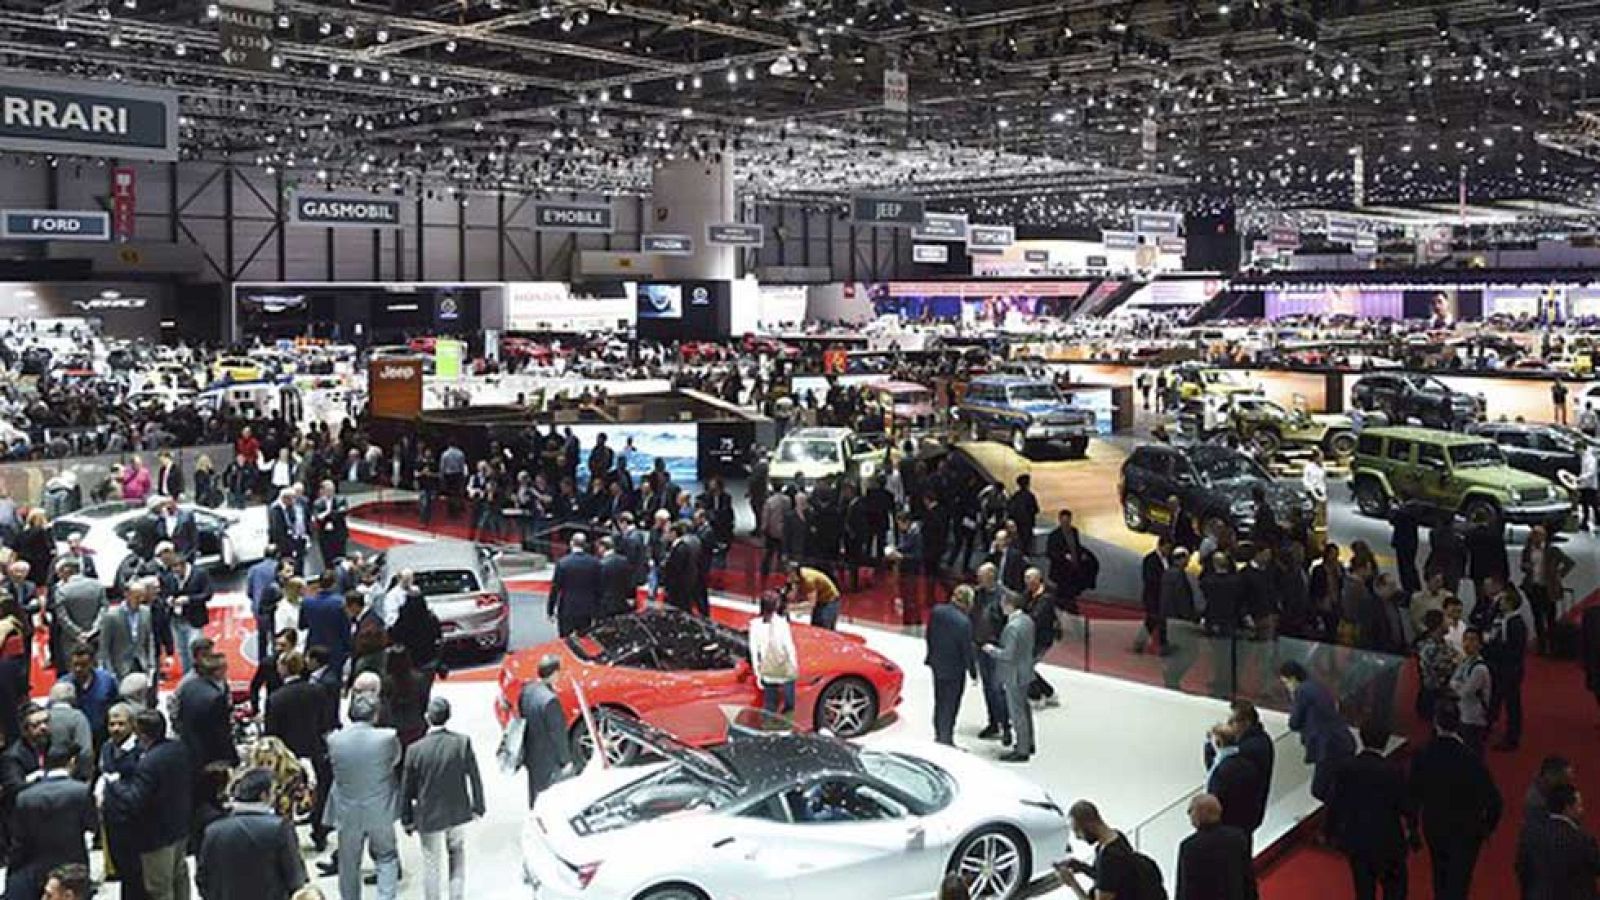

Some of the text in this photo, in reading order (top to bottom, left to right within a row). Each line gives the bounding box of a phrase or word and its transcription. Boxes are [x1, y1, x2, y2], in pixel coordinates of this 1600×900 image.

[4, 96, 128, 135] RRARI
[303, 202, 392, 219] GASMOBIL
[876, 202, 901, 220] JEEP
[31, 218, 80, 231] FORD
[379, 365, 414, 379] Jeep
